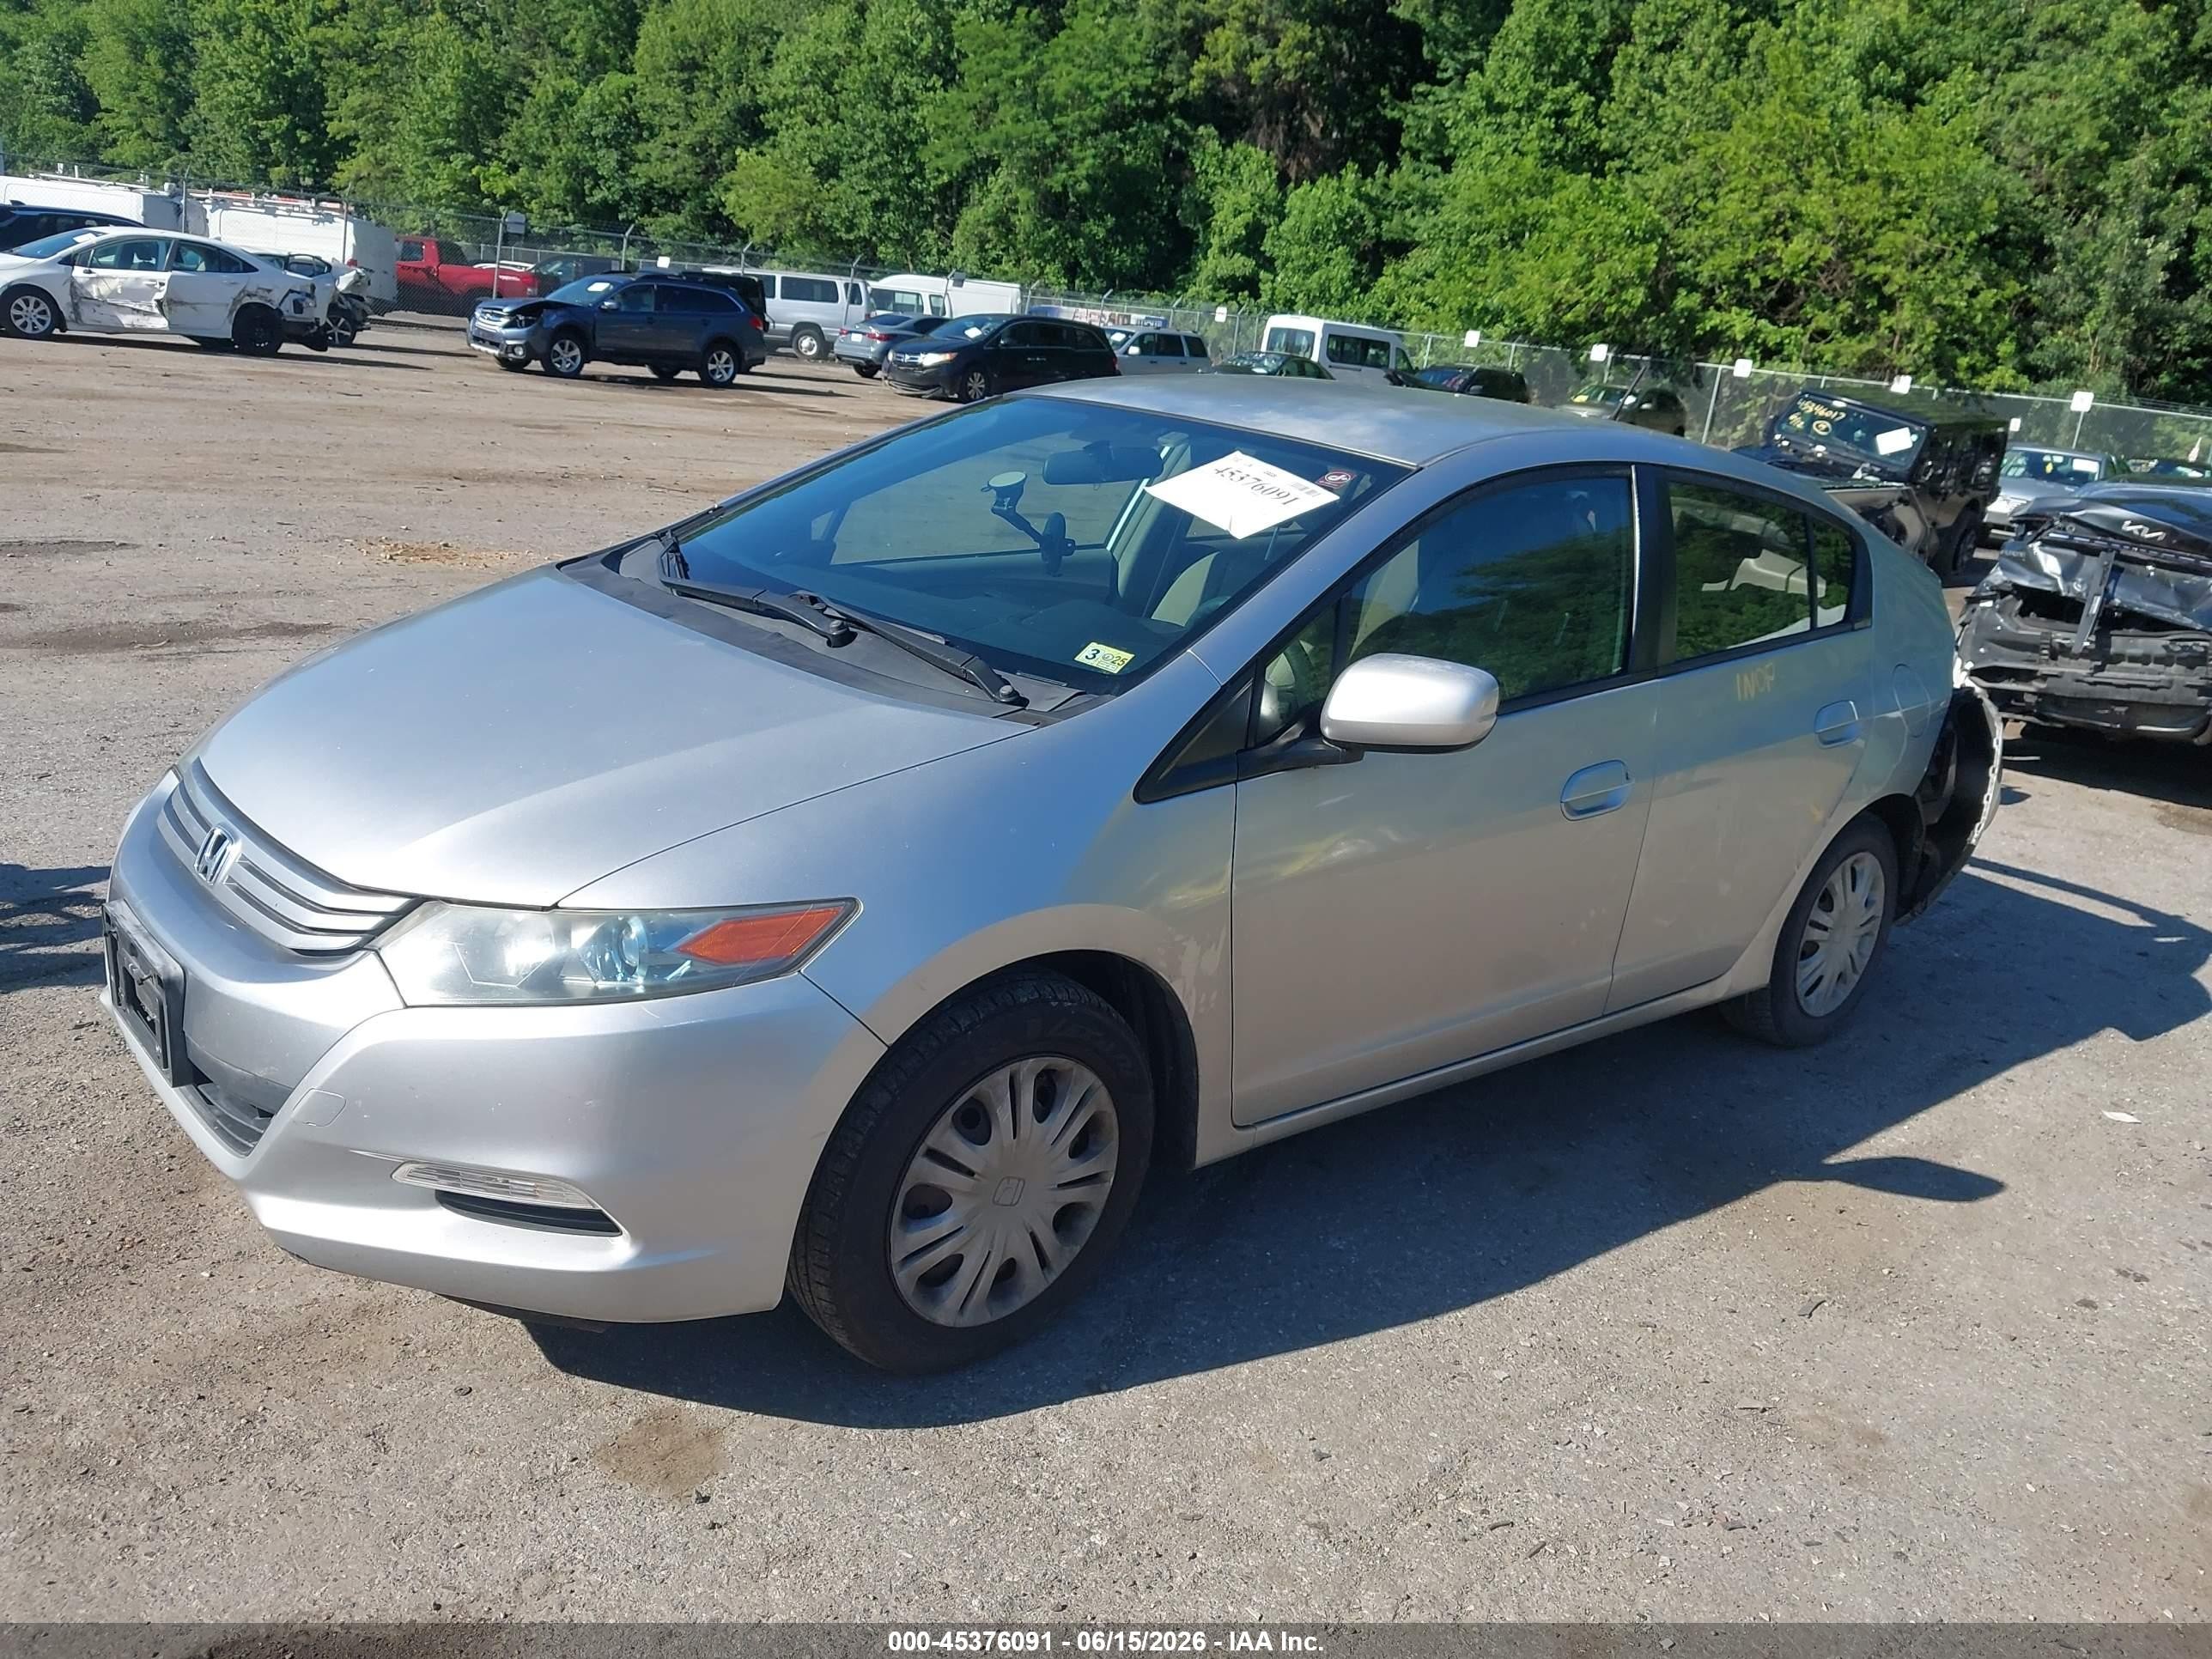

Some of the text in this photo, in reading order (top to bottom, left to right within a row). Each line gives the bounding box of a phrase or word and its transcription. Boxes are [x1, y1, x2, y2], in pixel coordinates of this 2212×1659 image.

[1214, 466, 1299, 505] 45376091
[1085, 648, 1100, 659] 3
[1110, 655, 1128, 666] 25
